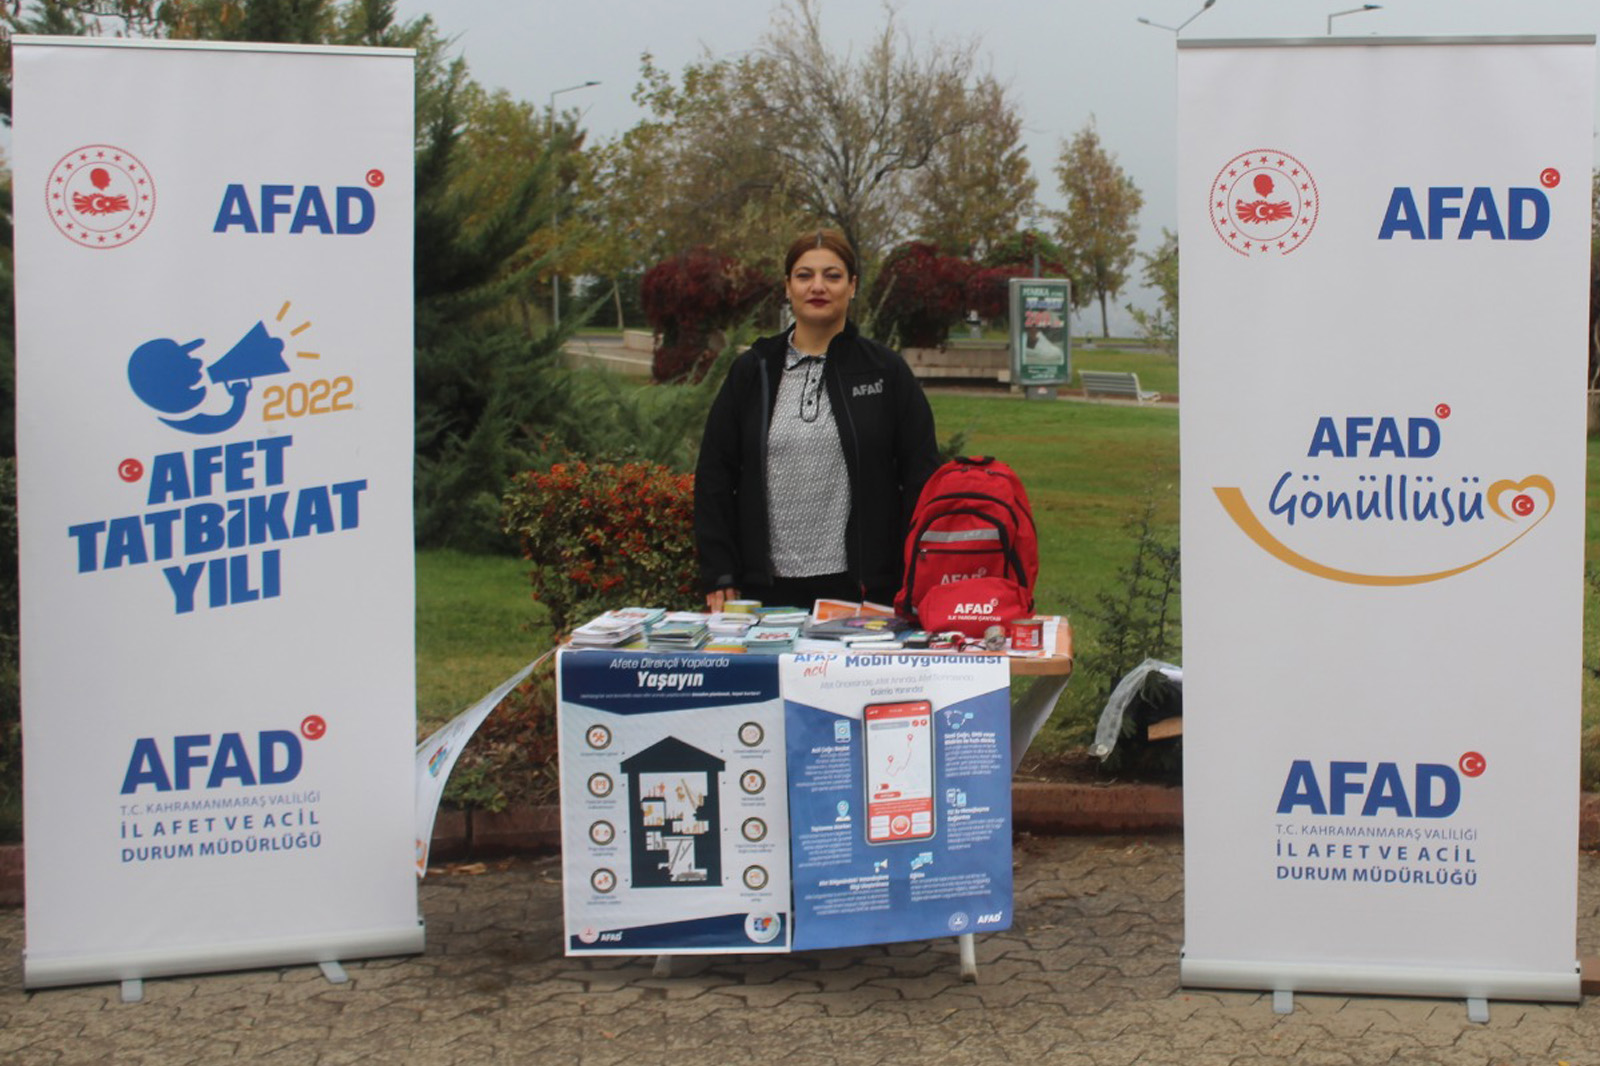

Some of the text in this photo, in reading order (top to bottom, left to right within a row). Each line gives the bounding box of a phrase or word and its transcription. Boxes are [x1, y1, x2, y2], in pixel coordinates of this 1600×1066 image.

[213, 184, 376, 235] AFAD
[1377, 186, 1551, 241] AFAD
[263, 376, 353, 421] 2022
[852, 382, 883, 397] AFAD
[1307, 416, 1441, 458] AFAD
[147, 435, 293, 506] AFET
[1268, 471, 1485, 527] Gönüllüsü
[162, 549, 281, 615] YILI
[953, 603, 994, 615] AFAD
[845, 654, 893, 668] Mobil
[637, 671, 704, 691] Yaşayın
[120, 730, 303, 795] AFAD
[120, 805, 144, 817] T.C.
[146, 794, 267, 814] KAHRAMANMARAŞ
[1276, 760, 1461, 819] AFAD
[153, 817, 216, 837] AFET
[225, 815, 254, 831] VE
[263, 808, 319, 829] ACİL
[1275, 824, 1477, 842] T.C. KAHRAMANMARAŞ VALİLİĞİ
[122, 831, 322, 863] DURUM MÜDÜRLÜĞÜ
[1307, 842, 1370, 859] AFET
[1379, 845, 1408, 861] VE
[1417, 842, 1476, 863] ACİL
[1276, 865, 1478, 887] DURUM MÜDÜRLÜĞÜ
